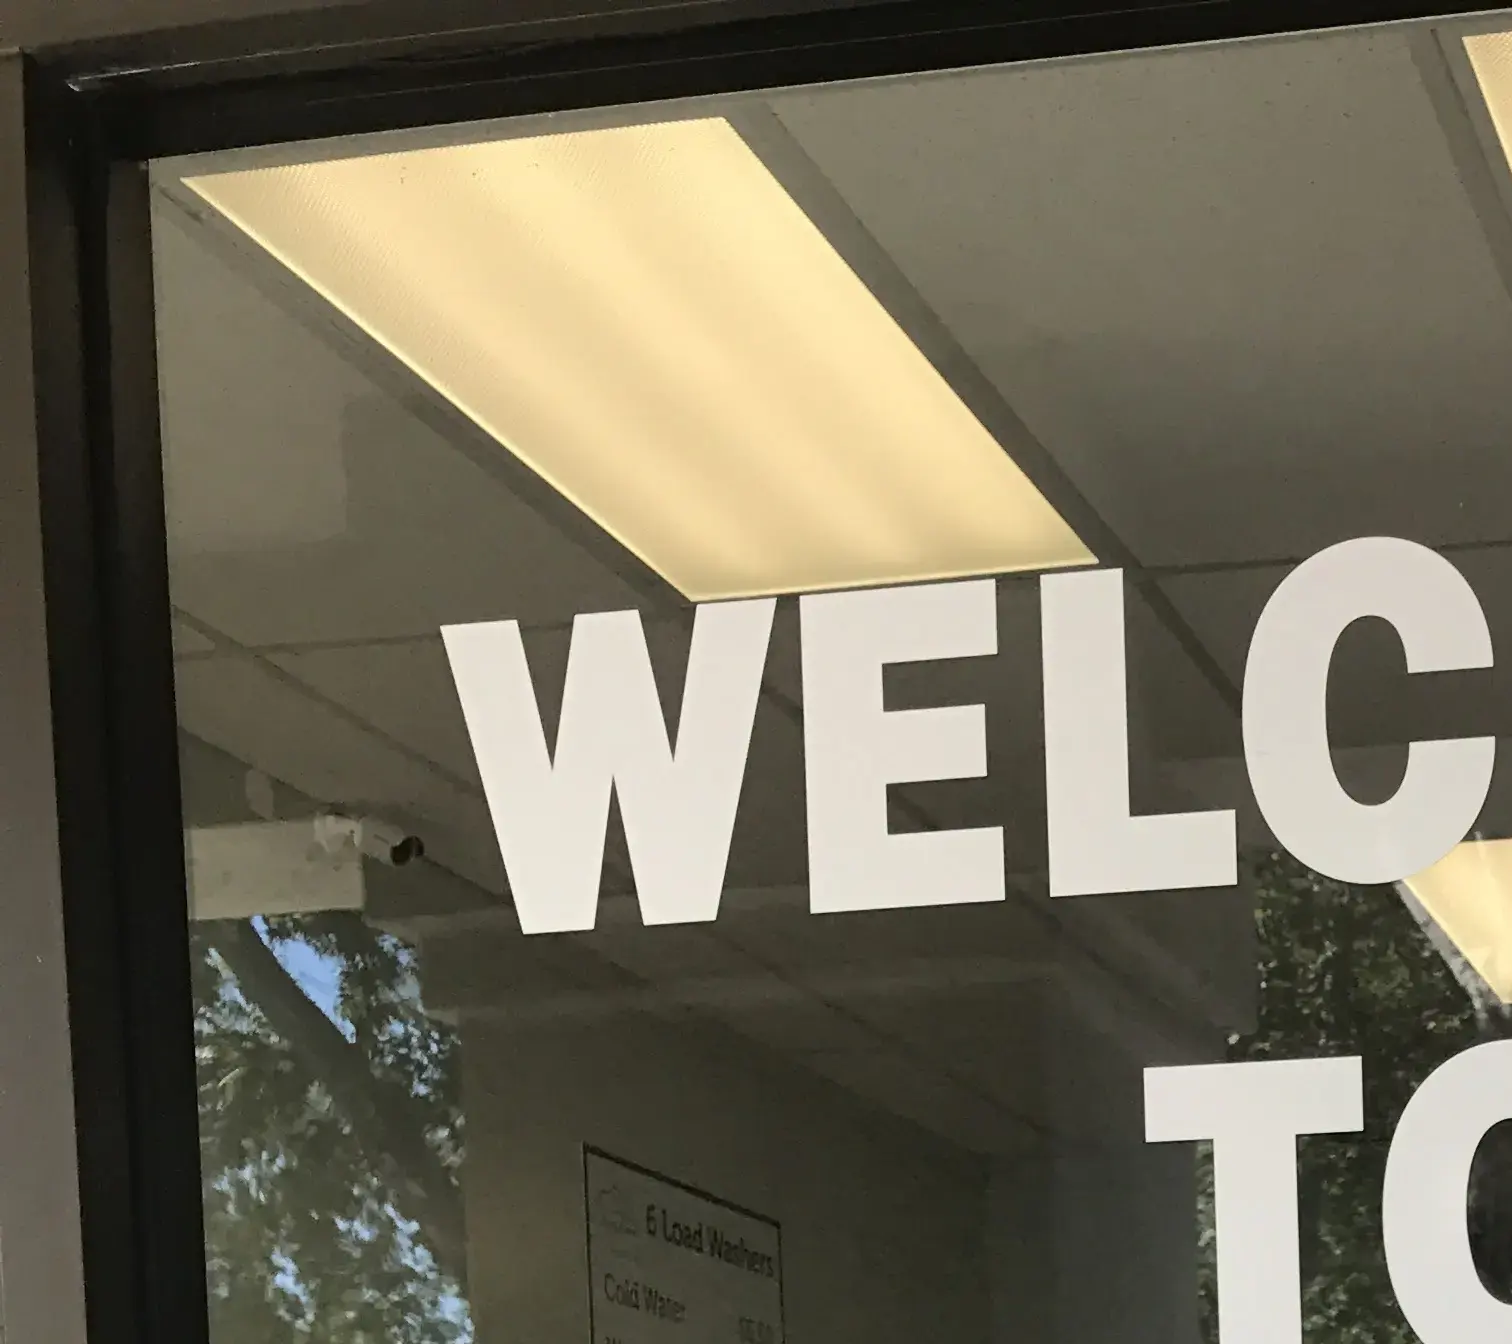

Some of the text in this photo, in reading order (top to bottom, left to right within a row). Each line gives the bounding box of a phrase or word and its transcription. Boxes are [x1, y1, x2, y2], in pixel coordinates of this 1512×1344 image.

[661, 1208, 704, 1254] Load
[707, 1225, 774, 1278] Washers
[604, 1272, 640, 1311] Cold
